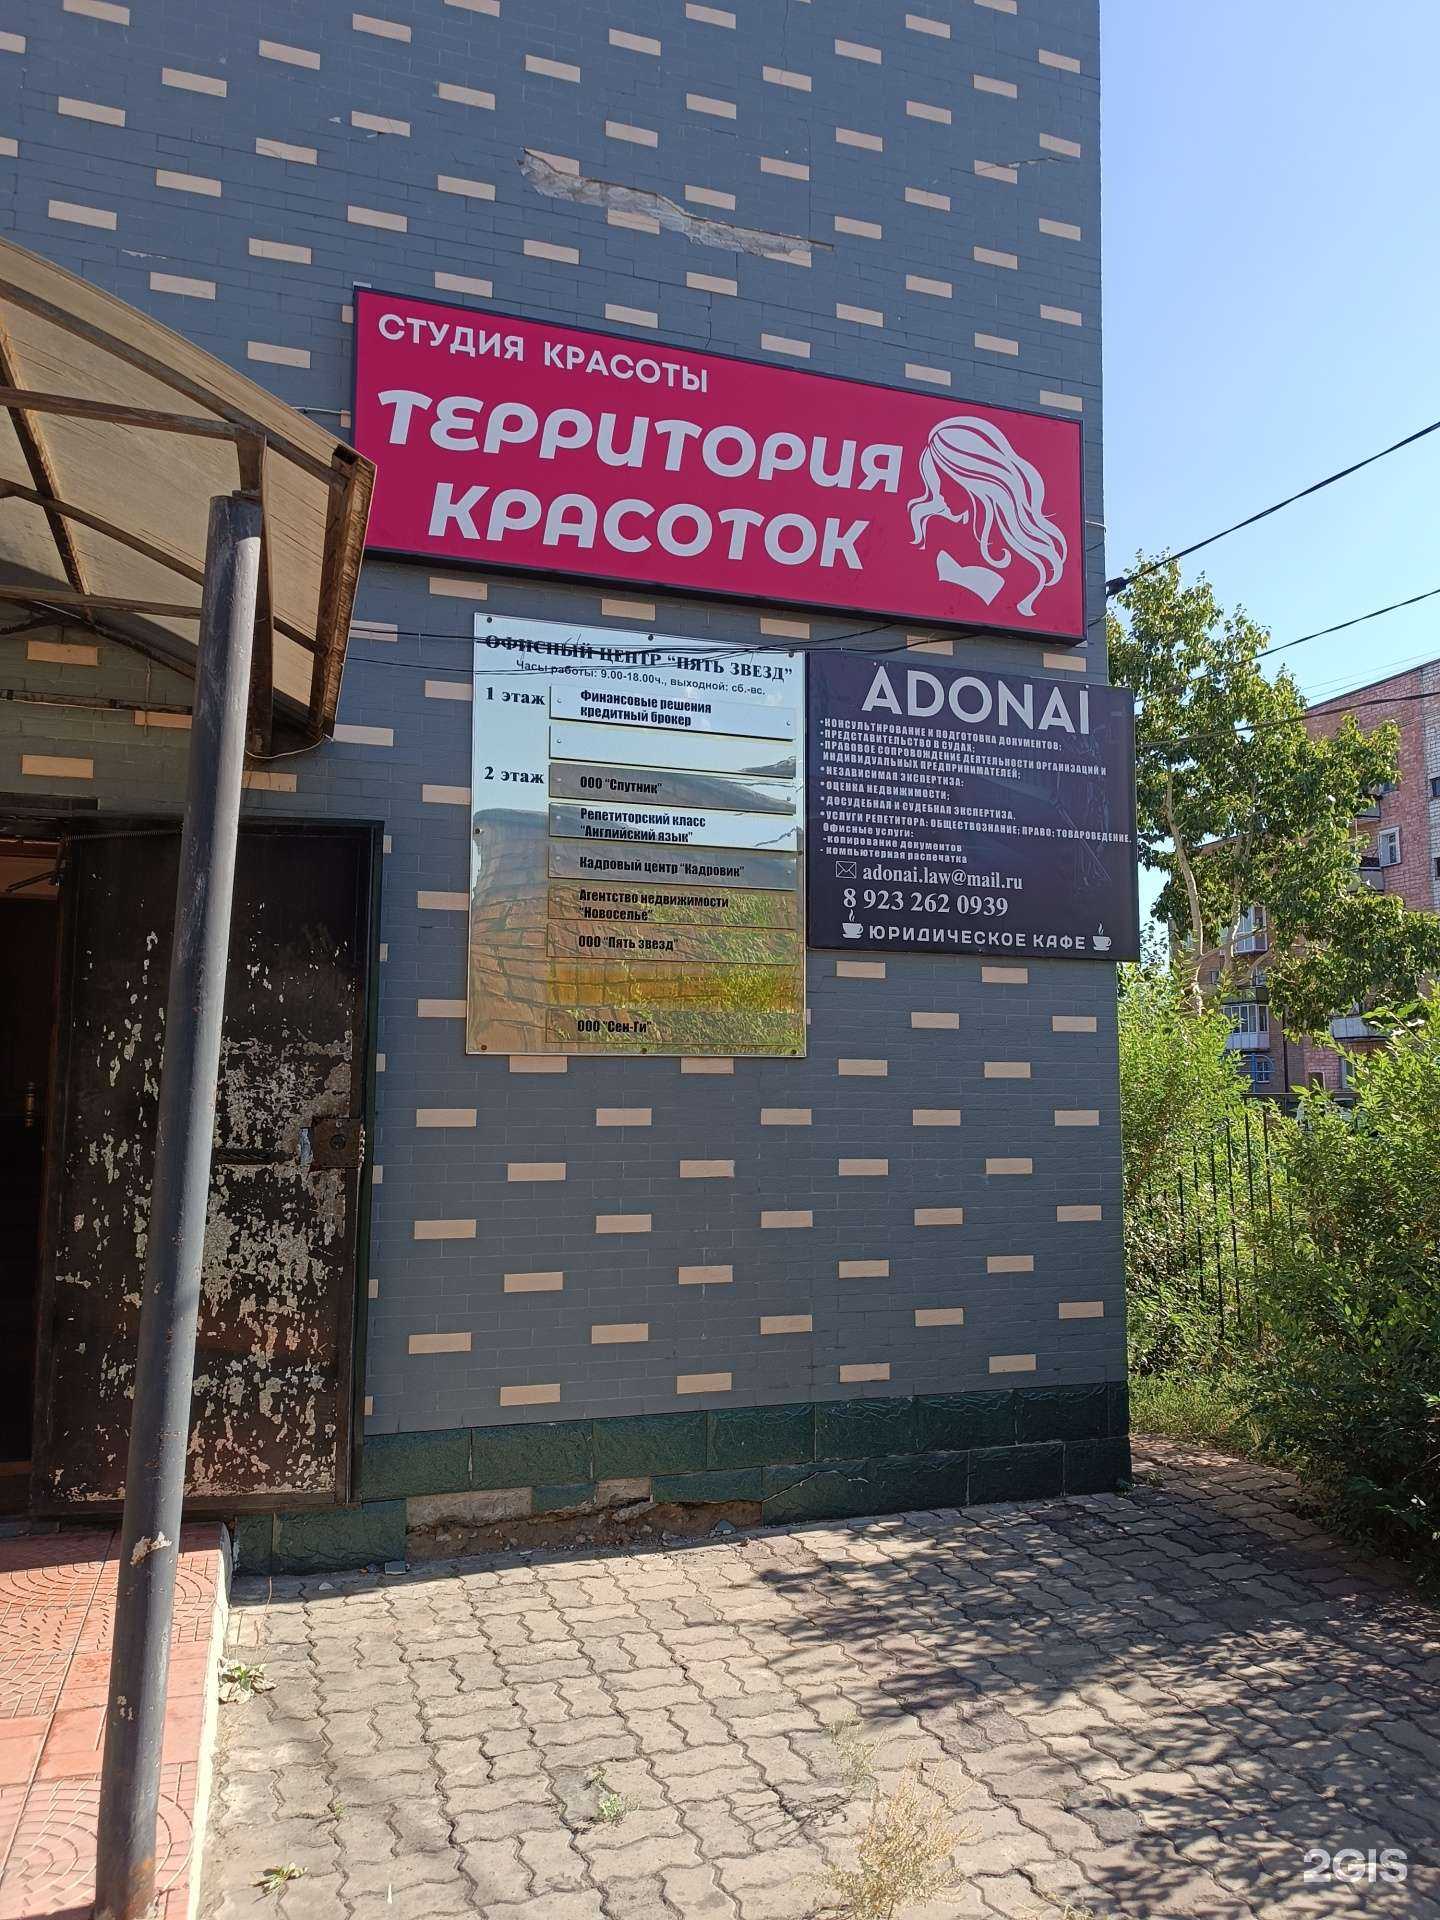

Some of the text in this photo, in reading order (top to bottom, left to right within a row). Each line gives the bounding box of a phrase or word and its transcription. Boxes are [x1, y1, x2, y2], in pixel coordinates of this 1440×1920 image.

[377, 313, 708, 393] СТУДИЯ КРАСОТЫ
[377, 390, 903, 493] ТЕРРИТОРИЯ
[427, 482, 869, 570] КРАСОТОК
[600, 647, 662, 666] ЦЕНТР
[516, 659, 548, 673] Часы
[551, 665, 598, 678] работы:
[670, 678, 729, 692] выходной:
[486, 687, 546, 706] 1 этаж
[580, 690, 712, 714] Финансовые решения
[861, 665, 1090, 735] ADONAI
[580, 705, 692, 727] кредитный брокер
[824, 718, 926, 737] КОНСУЛЬТИРОВАНИЕ
[928, 728, 934, 738] И
[936, 729, 997, 744] ПОДГОТОВКА
[824, 729, 932, 748] ПРЕДСТАВИТЕЛЬСТВО
[933, 739, 940, 749] В
[823, 751, 919, 769] ИНДИВИДУАЛЬНЫХ
[824, 740, 1107, 776] ПРАВОВОЕ СОПРОВОЖДЕНИЕ ДЕЯТЕЛЬНОСТИ ОРГАНИЗАЦИЙ И
[484, 767, 545, 785] 2 этаж
[580, 776, 603, 789] ООО
[826, 766, 899, 781] НЕЗАВИСИМАЯ
[826, 781, 865, 793] ОЦЕНКА
[826, 796, 893, 811] ДОСУДЕБНАЯ
[894, 801, 900, 811] И
[902, 802, 952, 815] СУДЕБНАЯ
[580, 808, 706, 828] Репетиторский класс
[826, 811, 864, 822] УСЛУГИ
[823, 822, 914, 838] Офисные услуги:
[899, 841, 962, 853] документов
[579, 856, 642, 872] Кадровый
[644, 862, 678, 876] центр
[907, 852, 968, 864] распечатка
[862, 864, 1024, 891] adonai.law@mail.ru
[579, 889, 730, 908] Агентство недвижимости
[843, 888, 1009, 917] 8 923 262 0939
[578, 935, 601, 948] ООО
[869, 925, 1086, 950] ЮРИДИЧЕСКОЕ КАФЕ
[577, 1020, 600, 1032] ООО
